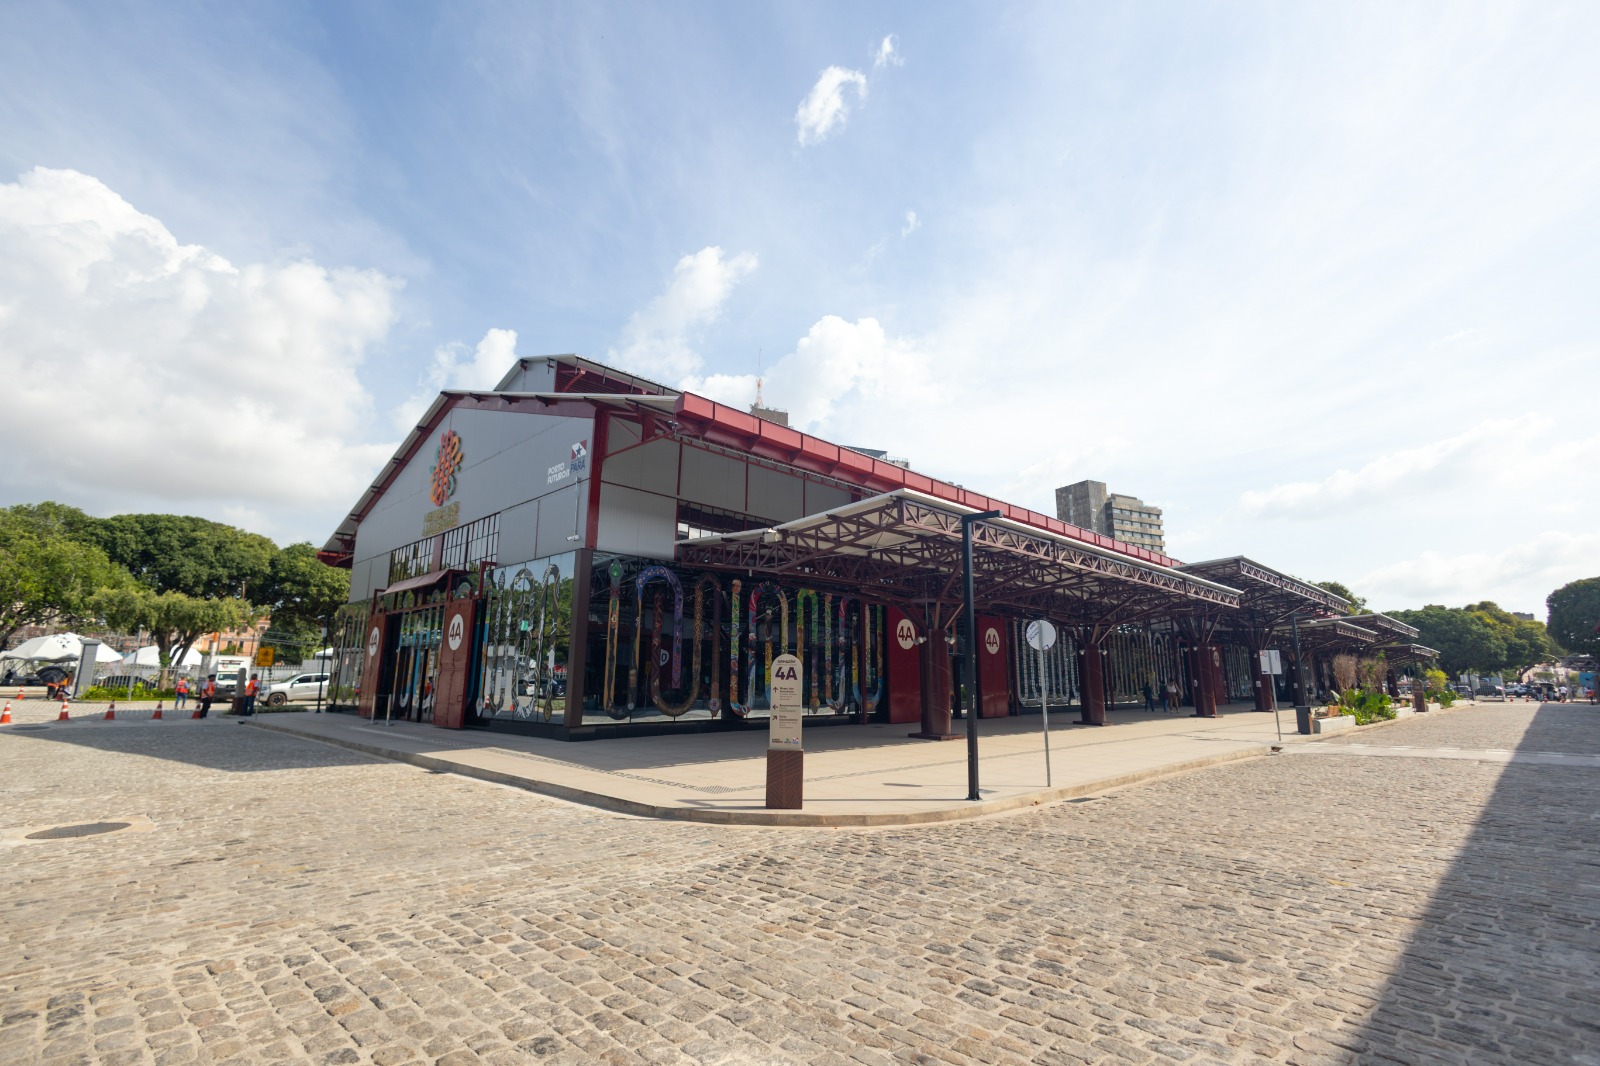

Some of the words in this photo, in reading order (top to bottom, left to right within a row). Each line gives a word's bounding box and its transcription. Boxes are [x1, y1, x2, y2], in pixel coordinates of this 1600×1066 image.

[547, 462, 565, 476] PORTO
[449, 622, 461, 641] 4A
[898, 625, 914, 641] 4A
[370, 634, 378, 648] 4A
[986, 634, 999, 648] 4A
[775, 666, 798, 680] 4A
